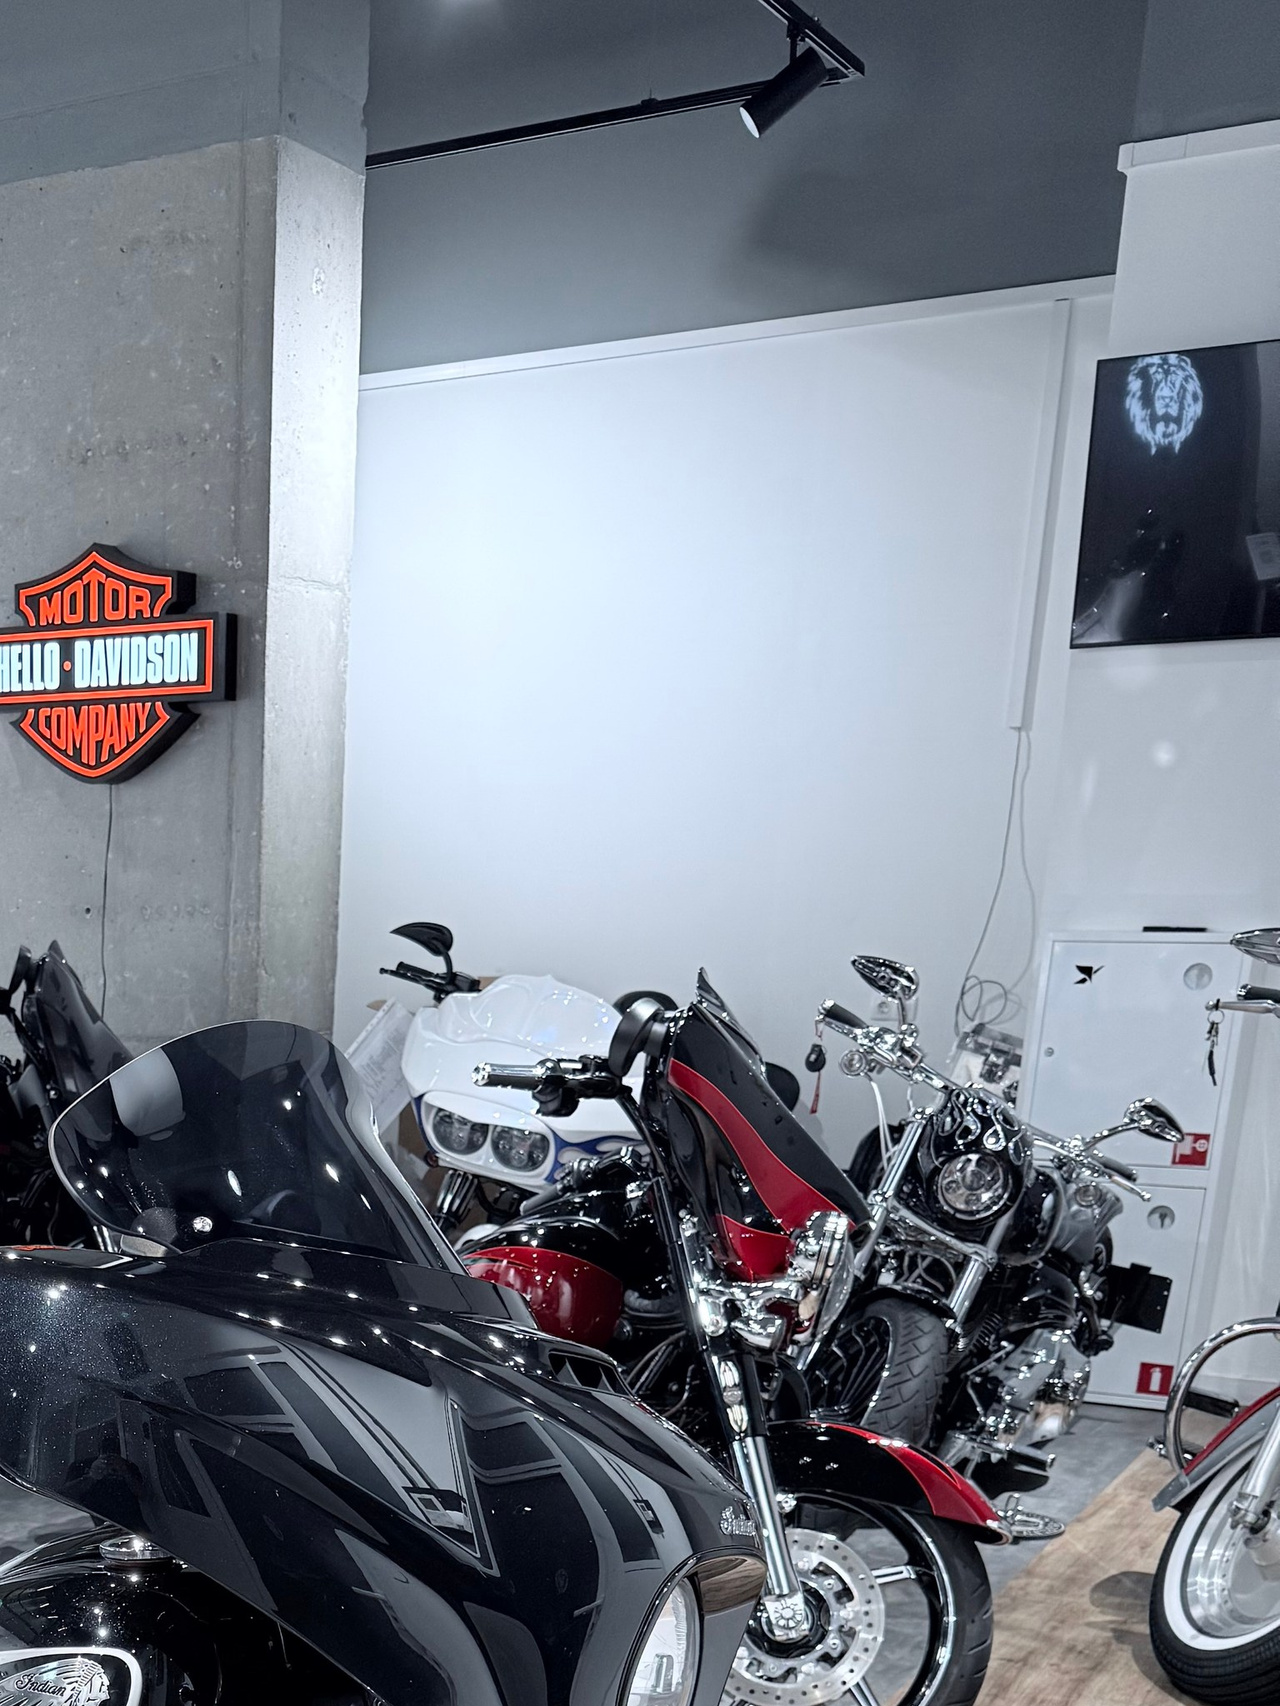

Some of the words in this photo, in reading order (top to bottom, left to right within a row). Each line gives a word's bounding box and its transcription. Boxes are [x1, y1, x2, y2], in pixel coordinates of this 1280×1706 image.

[39, 567, 151, 626] MOTOR
[74, 632, 199, 689] DAVIDSON
[38, 702, 152, 766] COMPANY
[15, 1672, 67, 1697] Indian
